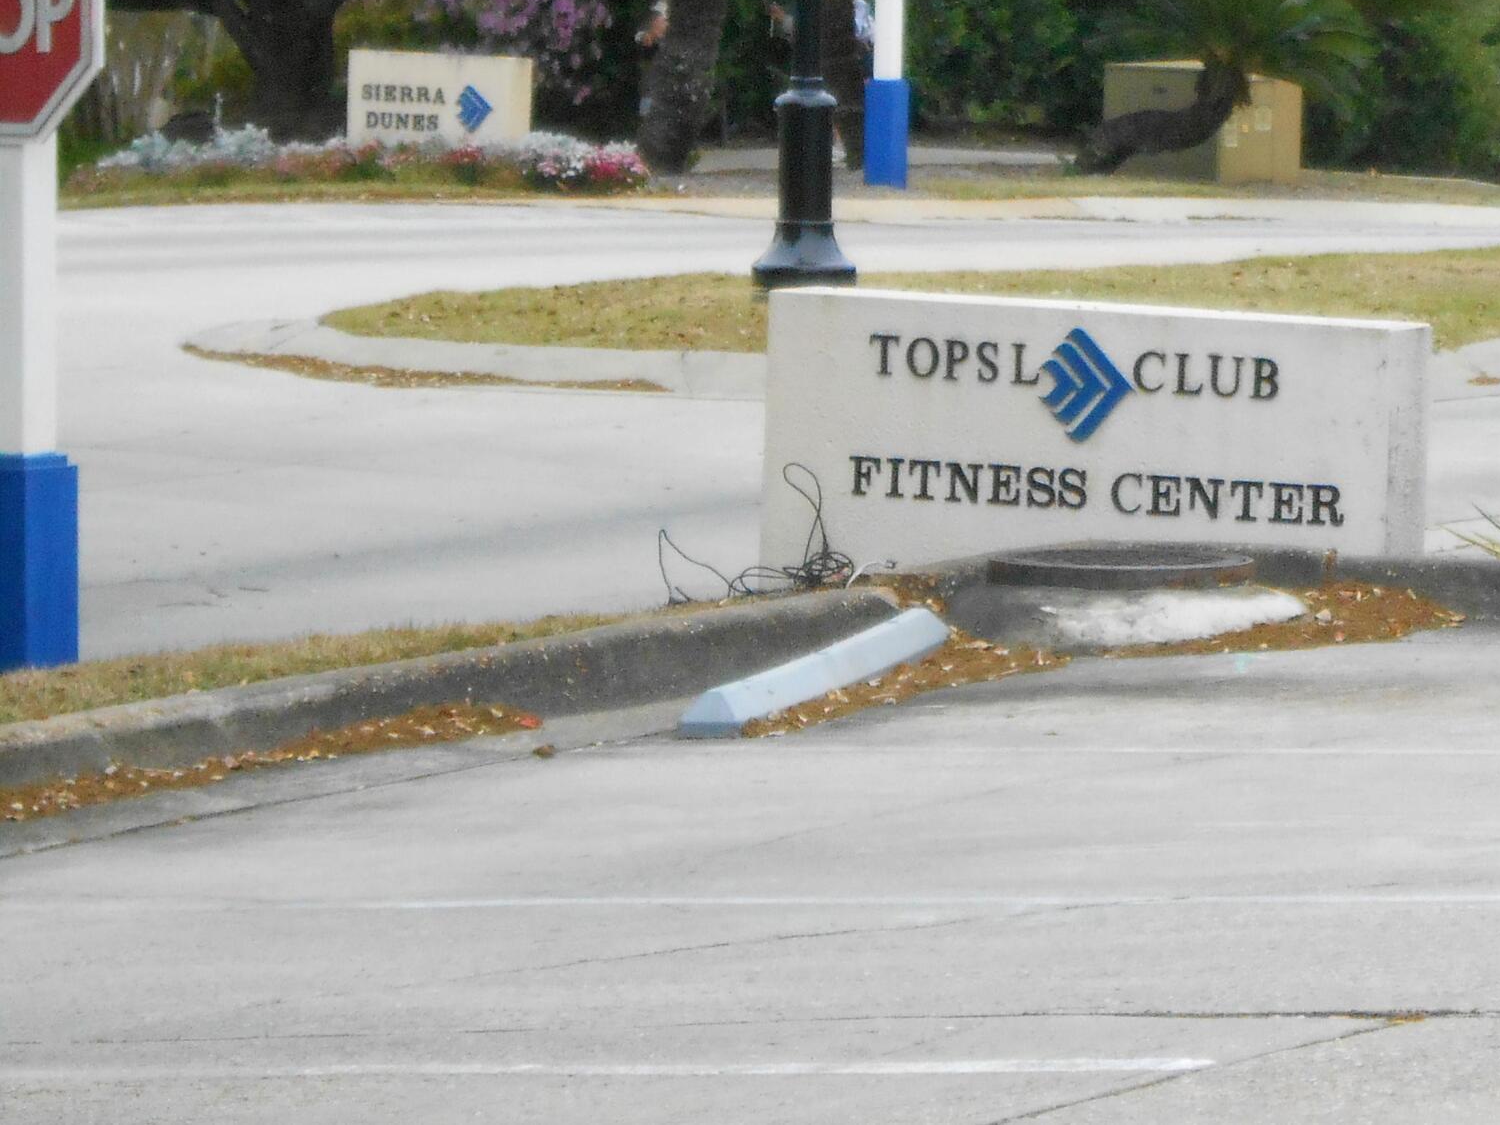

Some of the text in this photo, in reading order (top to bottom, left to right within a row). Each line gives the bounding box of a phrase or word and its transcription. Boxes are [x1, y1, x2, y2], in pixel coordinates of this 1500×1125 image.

[361, 83, 446, 105] SIERRA
[365, 110, 439, 131] DUNES
[1132, 350, 1279, 401] CLUB
[849, 455, 1344, 527] FITNESS CENTER
